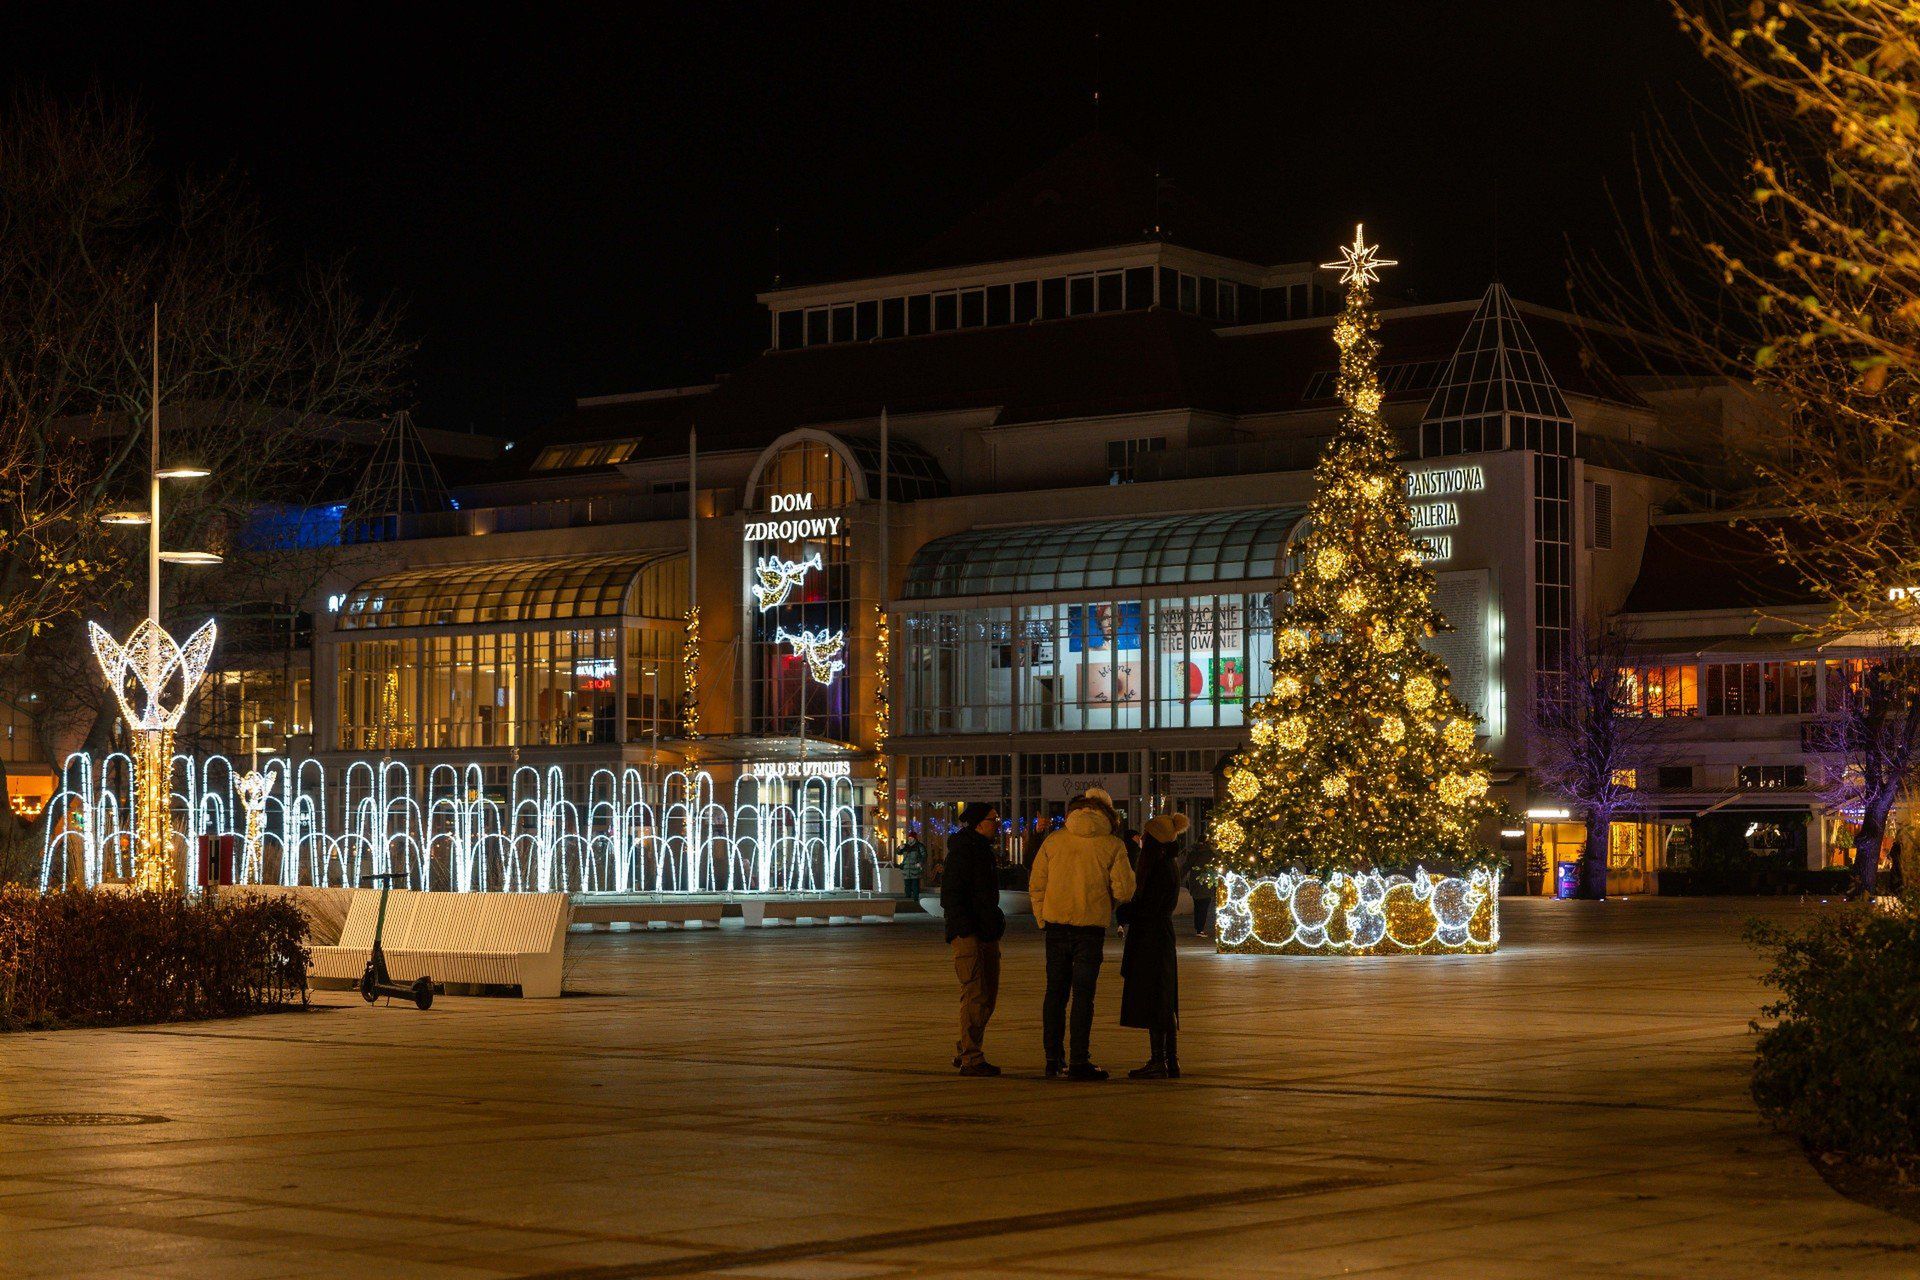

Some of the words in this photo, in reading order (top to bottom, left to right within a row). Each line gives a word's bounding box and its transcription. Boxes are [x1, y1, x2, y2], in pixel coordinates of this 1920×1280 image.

[1407, 467, 1483, 496] PAŃSTWOWA
[770, 492, 813, 513] DOM
[1408, 503, 1457, 528] GALERIA
[744, 517, 840, 543] ZDROJOWY
[1162, 635, 1237, 652] TREOWNIE
[754, 762, 786, 776] MOLO
